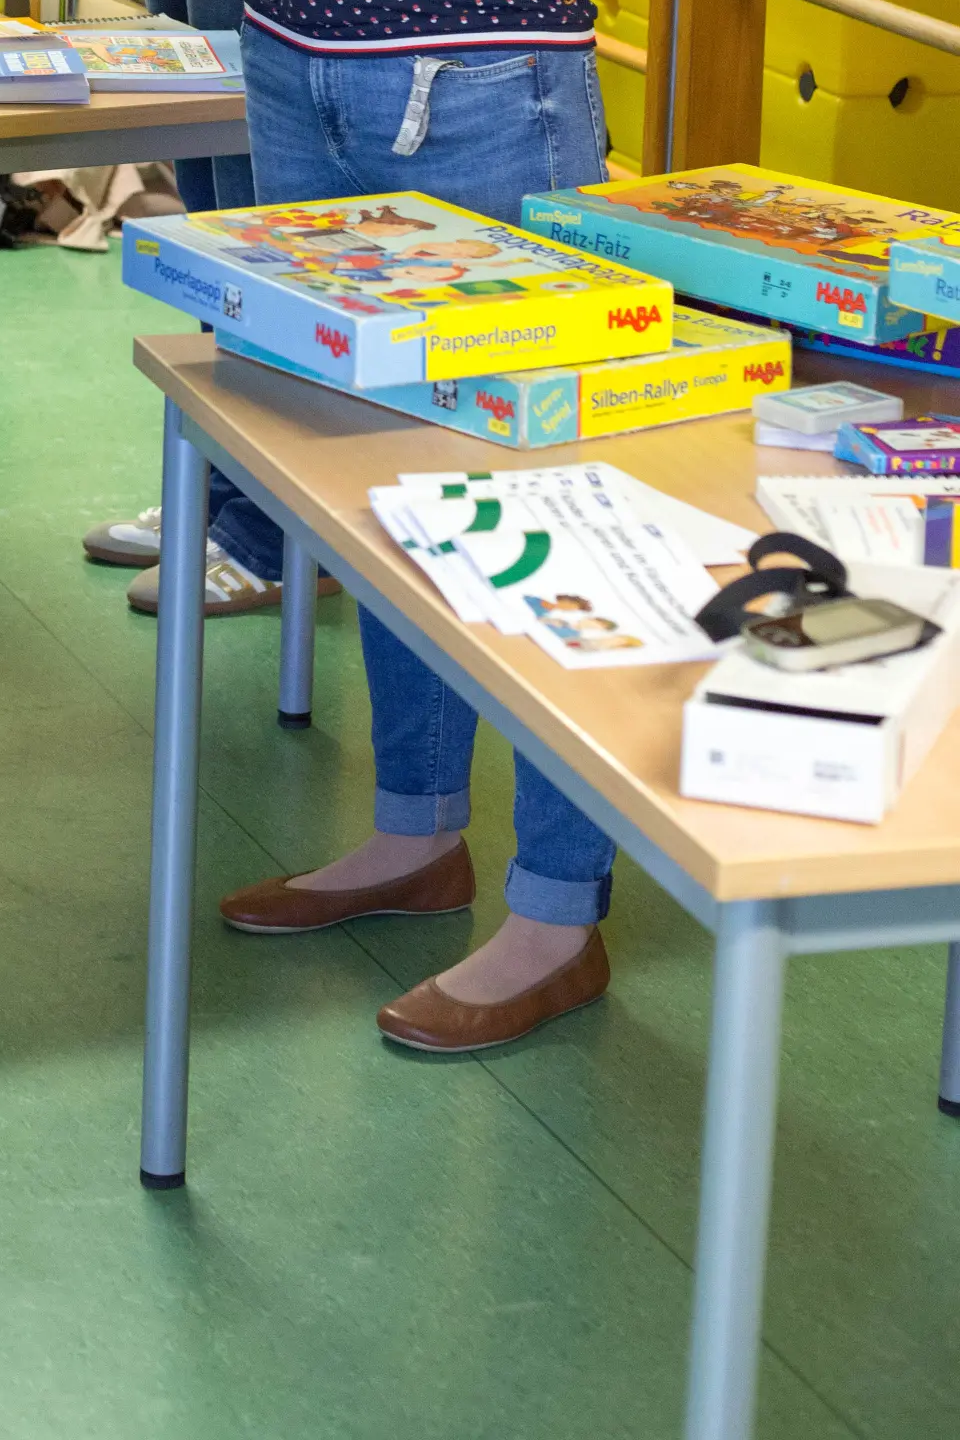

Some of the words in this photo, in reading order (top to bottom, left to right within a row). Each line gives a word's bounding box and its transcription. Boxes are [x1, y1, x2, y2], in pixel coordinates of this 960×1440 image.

[475, 225, 646, 286] Papperlapapp
[550, 222, 631, 260] Ratz-Fatz
[154, 256, 221, 303] Papperlapapp
[816, 281, 868, 314] HABA
[608, 305, 662, 333] HABA
[315, 322, 352, 359] HABA
[430, 324, 557, 354] Papperlapapp
[743, 361, 784, 385] HABA
[476, 390, 515, 421] HABA
[591, 379, 689, 410] Silben-Rallye
